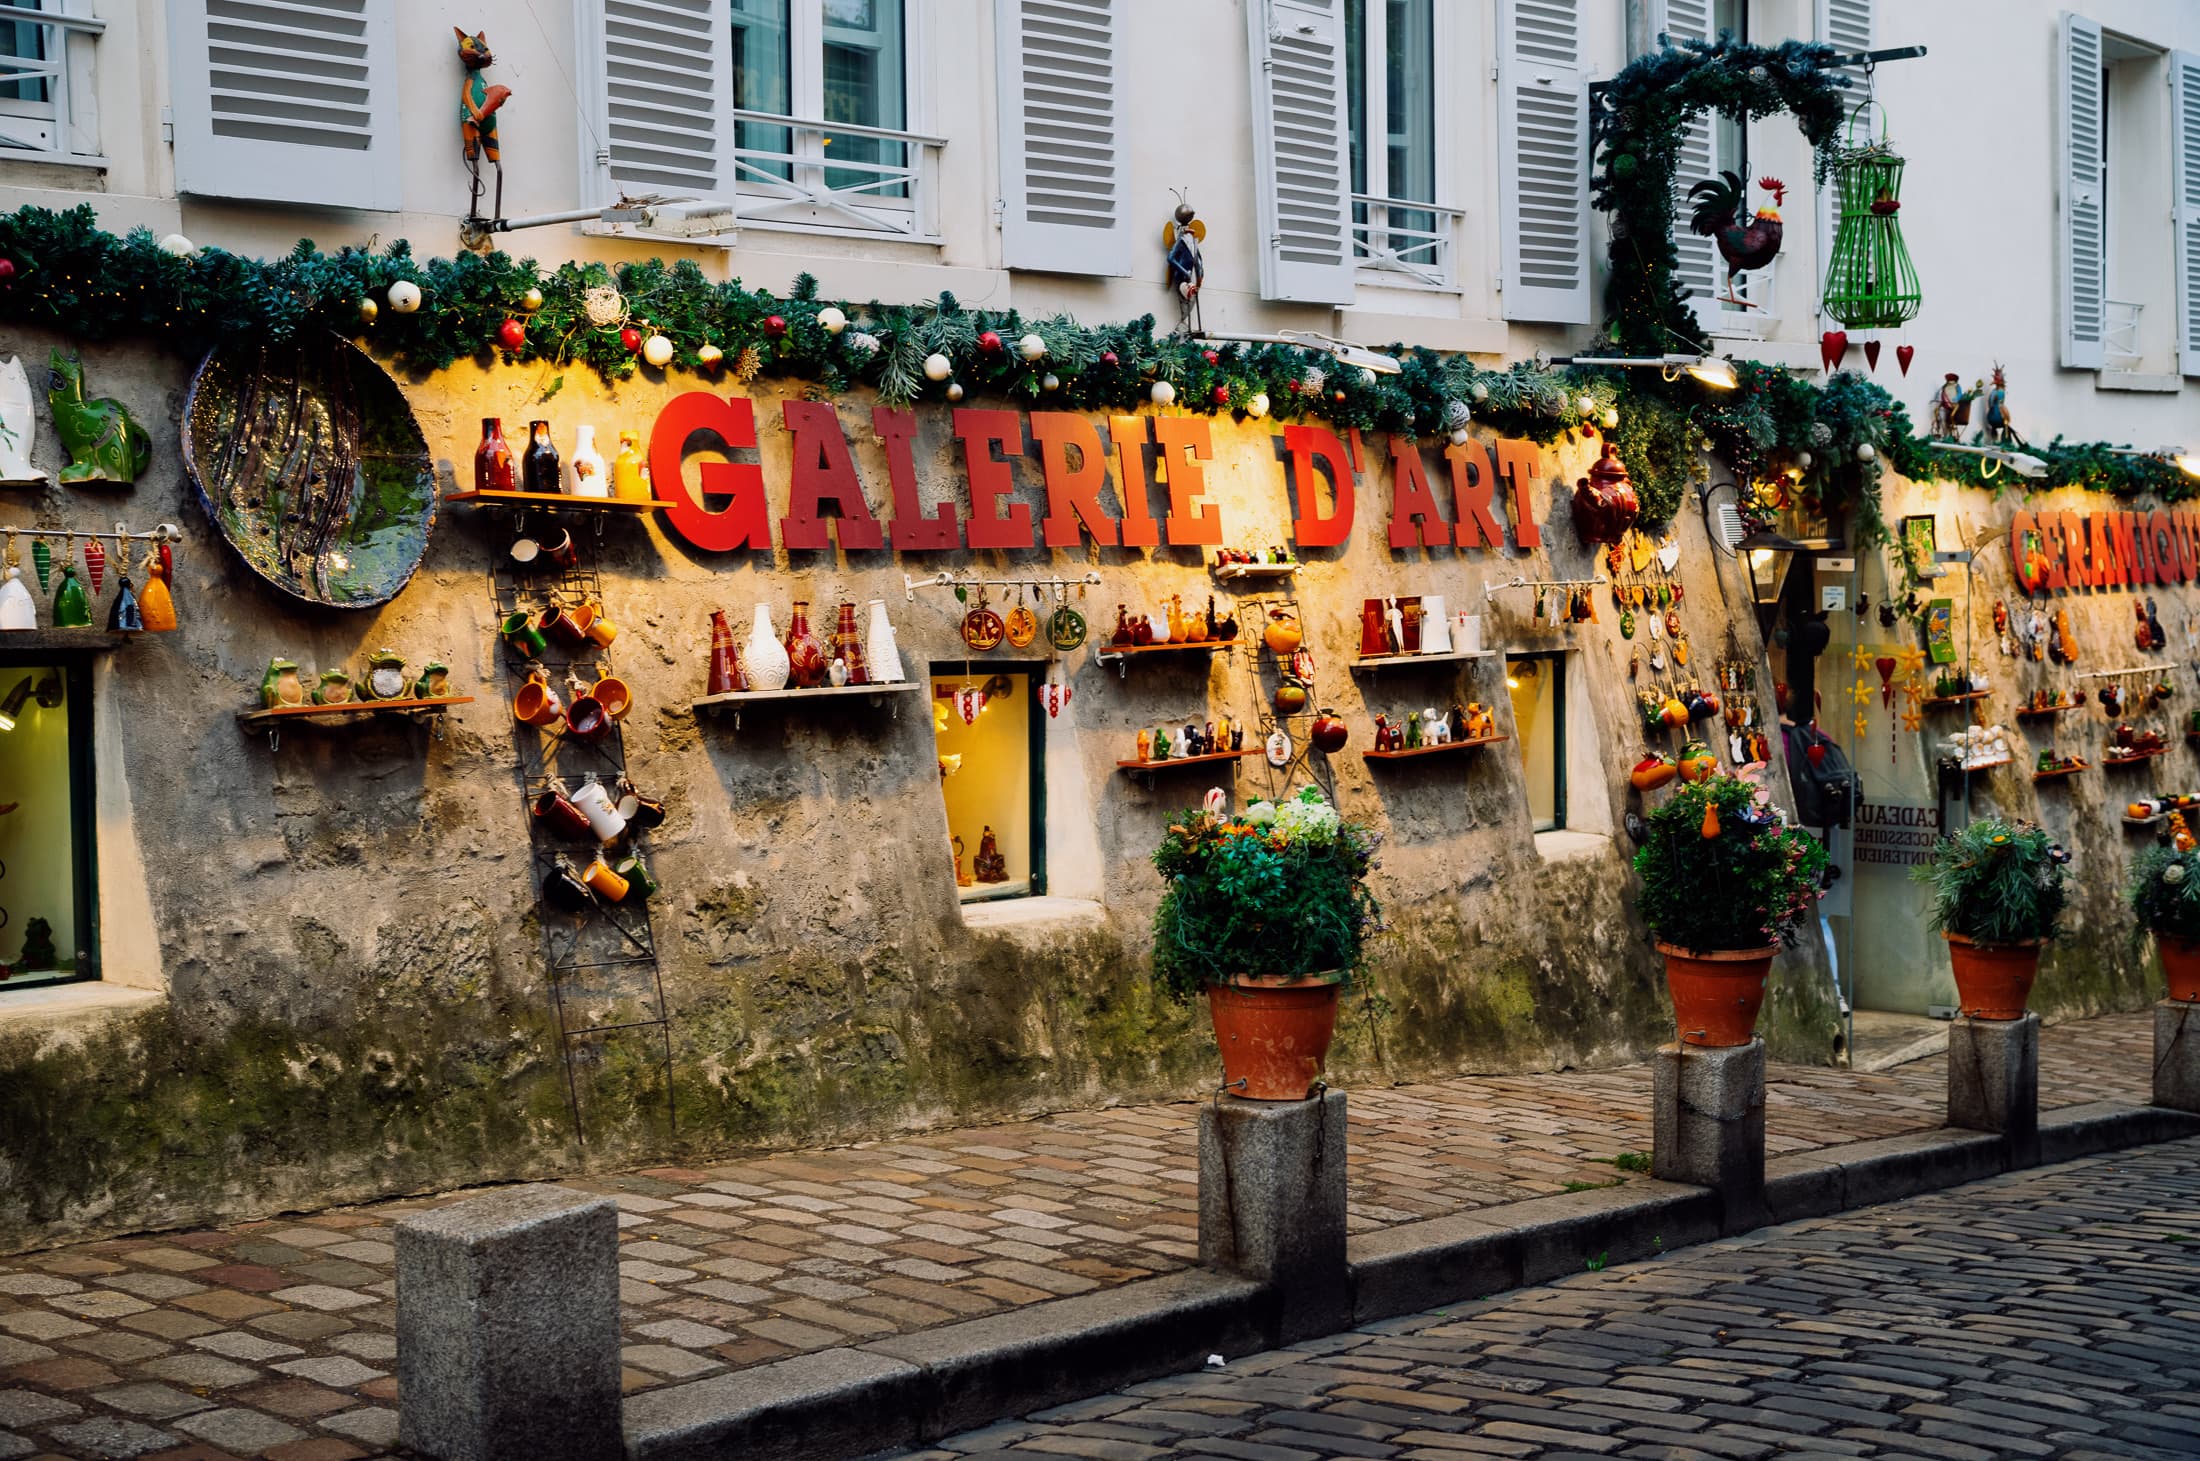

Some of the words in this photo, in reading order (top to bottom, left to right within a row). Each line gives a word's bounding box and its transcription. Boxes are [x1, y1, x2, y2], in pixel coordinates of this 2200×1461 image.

[648, 391, 1223, 551] GALERIE
[1284, 424, 1542, 548] D'ART
[2012, 510, 2200, 592] CERAMIQU
